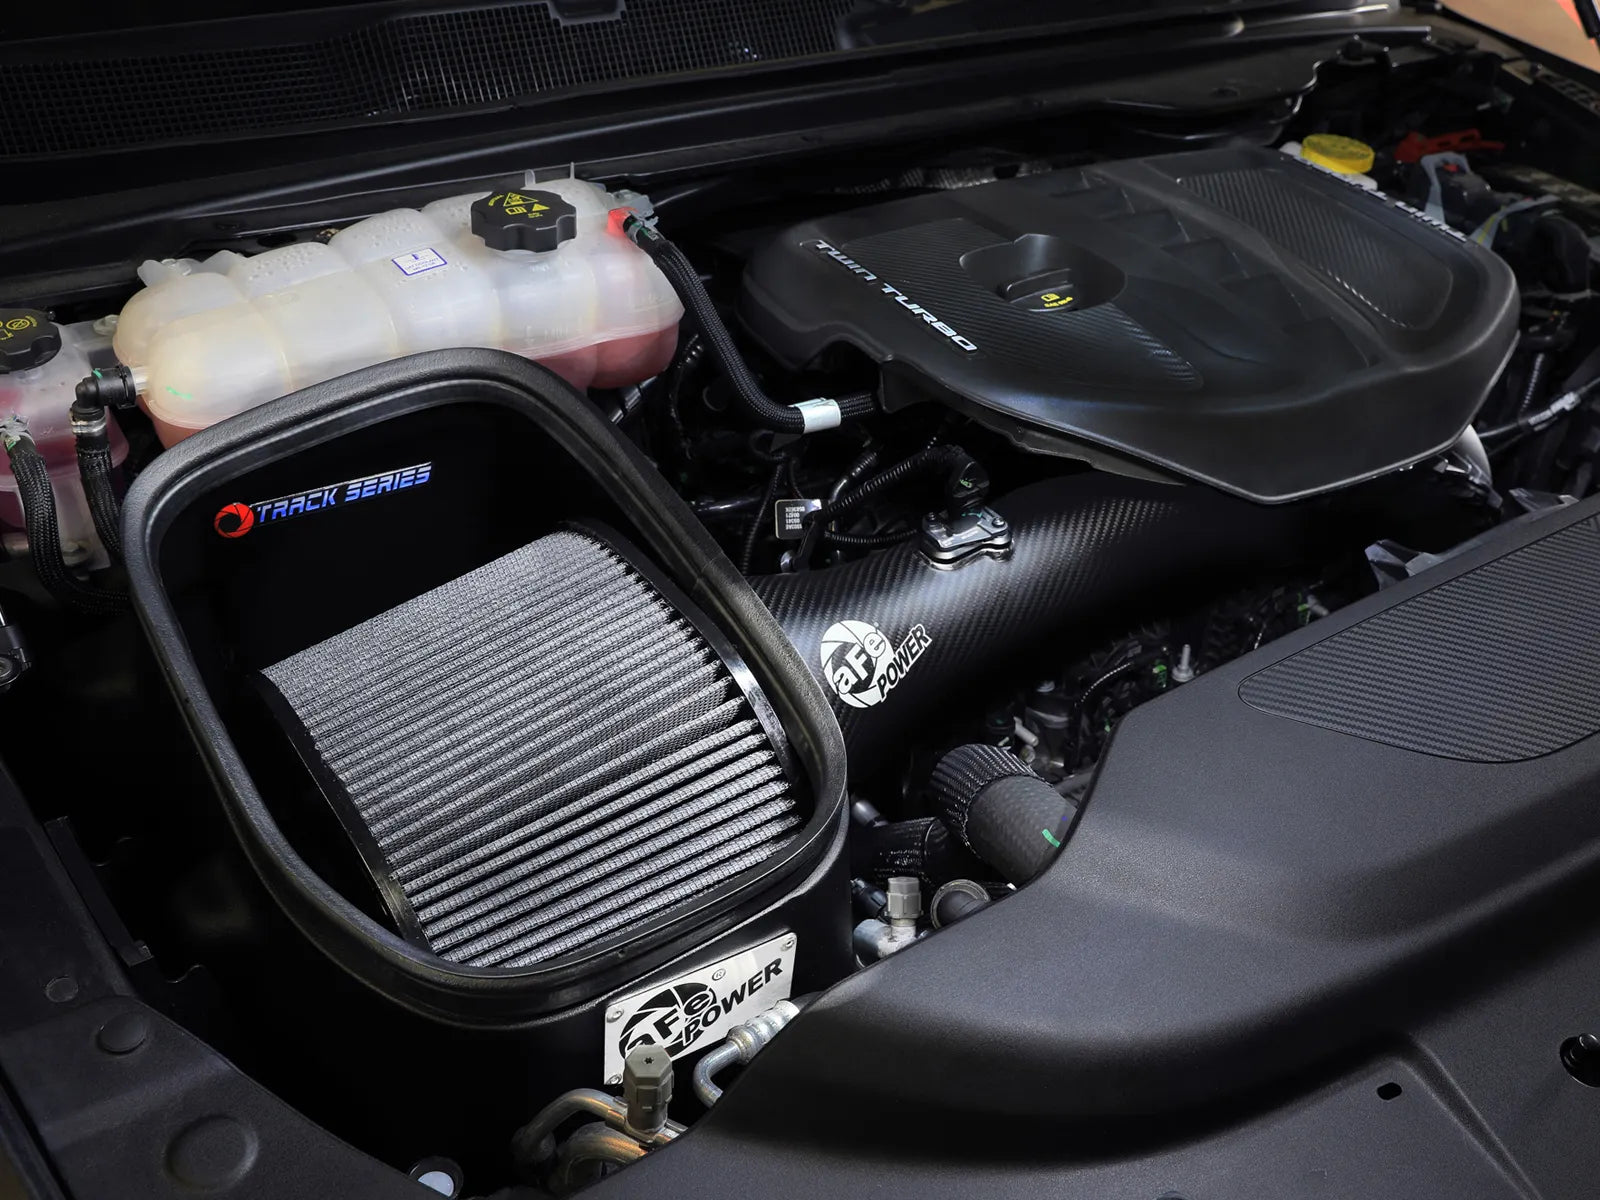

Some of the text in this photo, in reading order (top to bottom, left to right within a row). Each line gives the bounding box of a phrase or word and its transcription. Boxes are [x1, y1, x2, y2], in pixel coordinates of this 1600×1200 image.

[881, 283, 978, 351] TURBO
[257, 466, 432, 522] TRACK SERIES
[833, 632, 886, 694] aFe
[876, 625, 932, 701] POWER
[684, 958, 783, 1044] POWER
